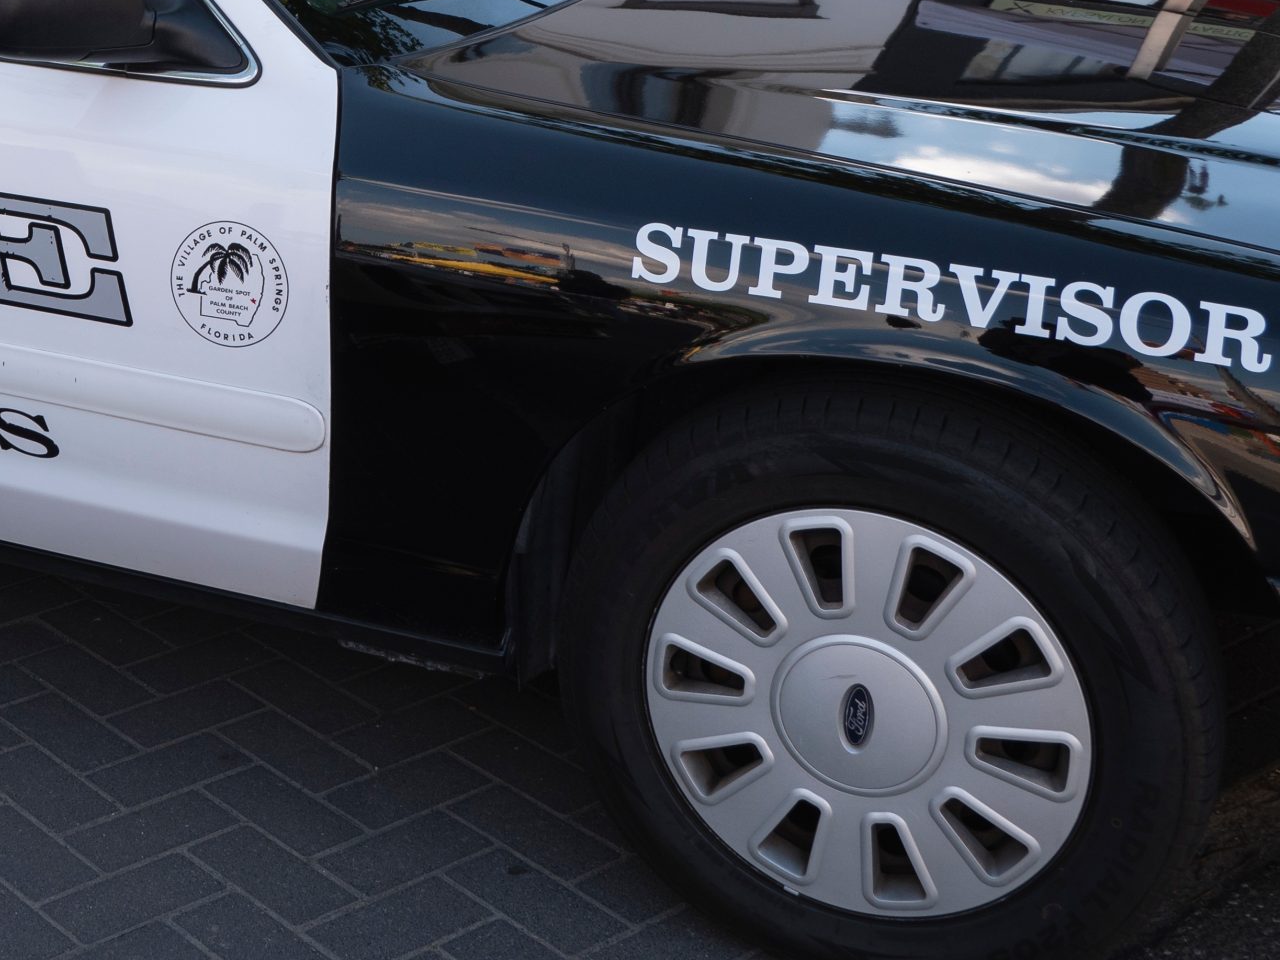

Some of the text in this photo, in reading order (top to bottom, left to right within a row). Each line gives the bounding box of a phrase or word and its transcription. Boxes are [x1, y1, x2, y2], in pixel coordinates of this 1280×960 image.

[176, 226, 284, 313] THE VILLAGE OF PALM SPRINGS
[208, 285, 251, 297] GARDEN SPOT
[631, 222, 1273, 373] SUPERVISOR
[209, 300, 249, 311] PALM BEACH
[216, 308, 242, 317] COUNTY
[200, 323, 254, 342] FLORIDA
[848, 698, 865, 735] Ford
